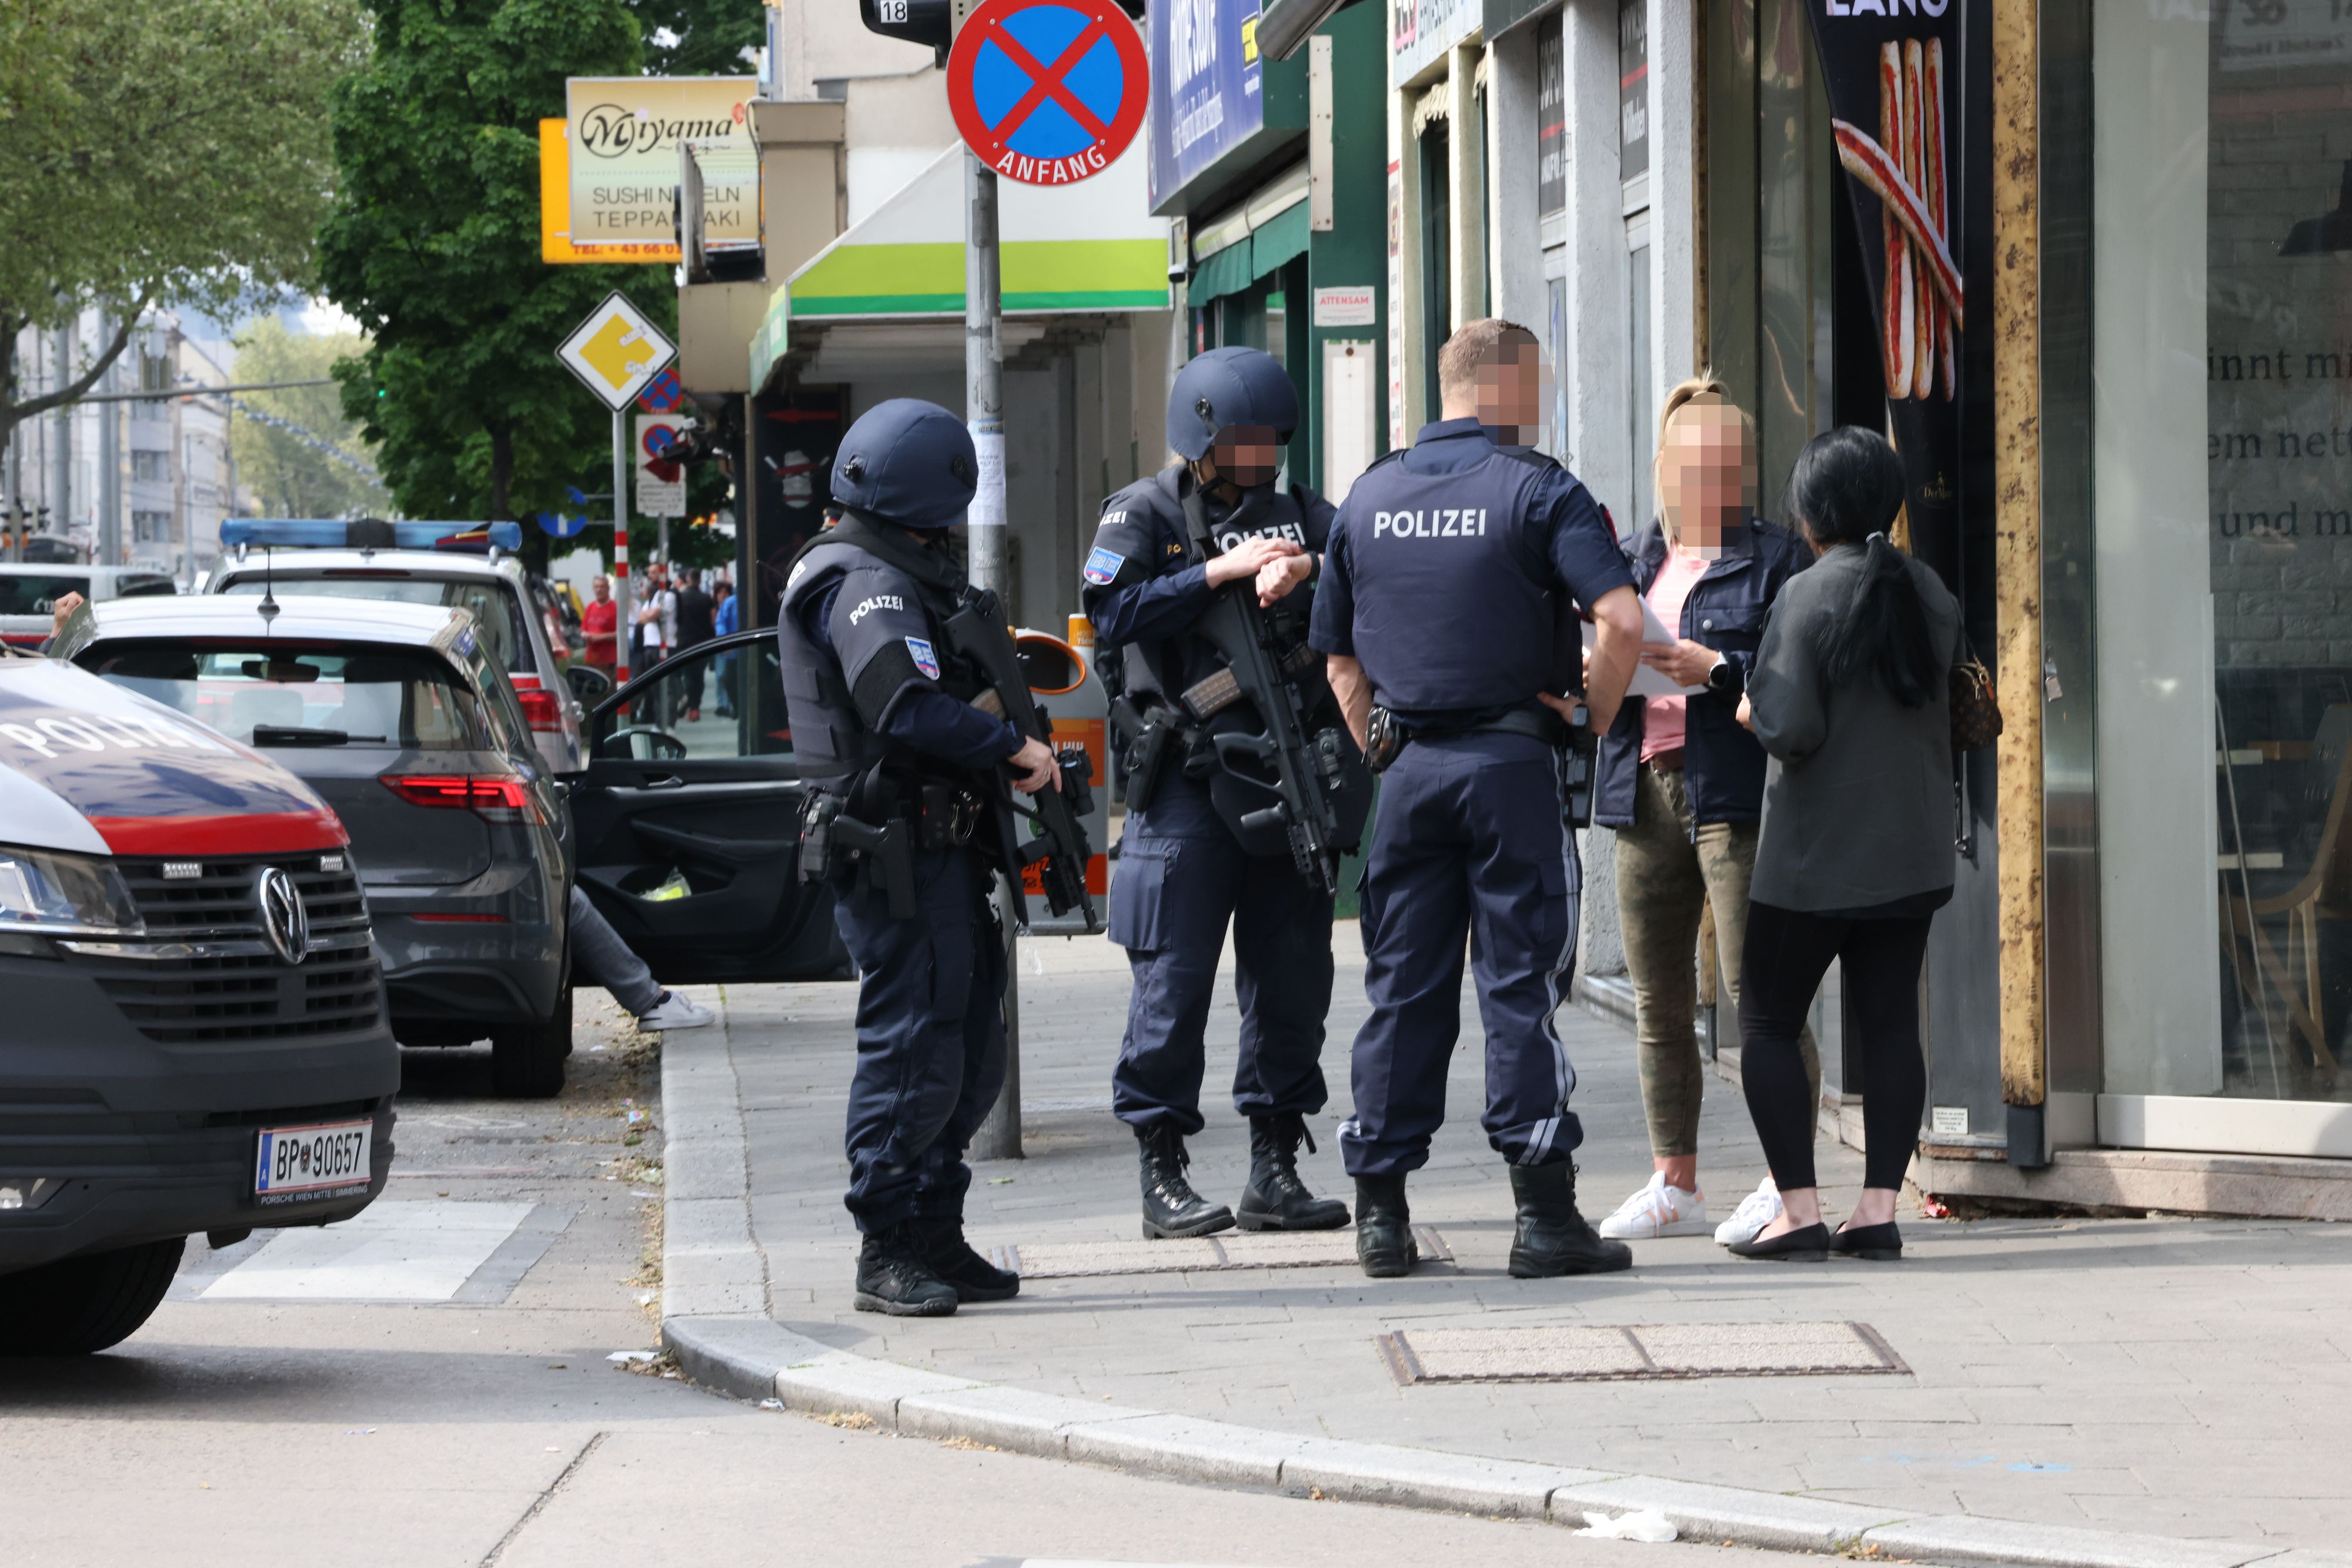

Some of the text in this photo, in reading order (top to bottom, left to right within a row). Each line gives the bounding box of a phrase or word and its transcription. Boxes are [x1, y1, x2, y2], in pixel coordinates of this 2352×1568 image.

[883, 2, 906, 21] 18
[581, 107, 733, 155] Miyama
[996, 145, 1107, 183] ANFANG
[593, 186, 740, 205] SUSHI NELN
[593, 210, 740, 228] TEPPAAKI
[1320, 295, 1369, 306] ATTENSAM
[1374, 508, 1487, 539] POLIZEI
[1090, 553, 1120, 574] BE
[849, 595, 903, 626] POLIZEI
[0, 715, 219, 758] POLIZ
[276, 1131, 363, 1181] BP 90657
[260, 1169, 267, 1182] A
[261, 1183, 368, 1206] PORSCHE WIEN MITTE SIMMERING
